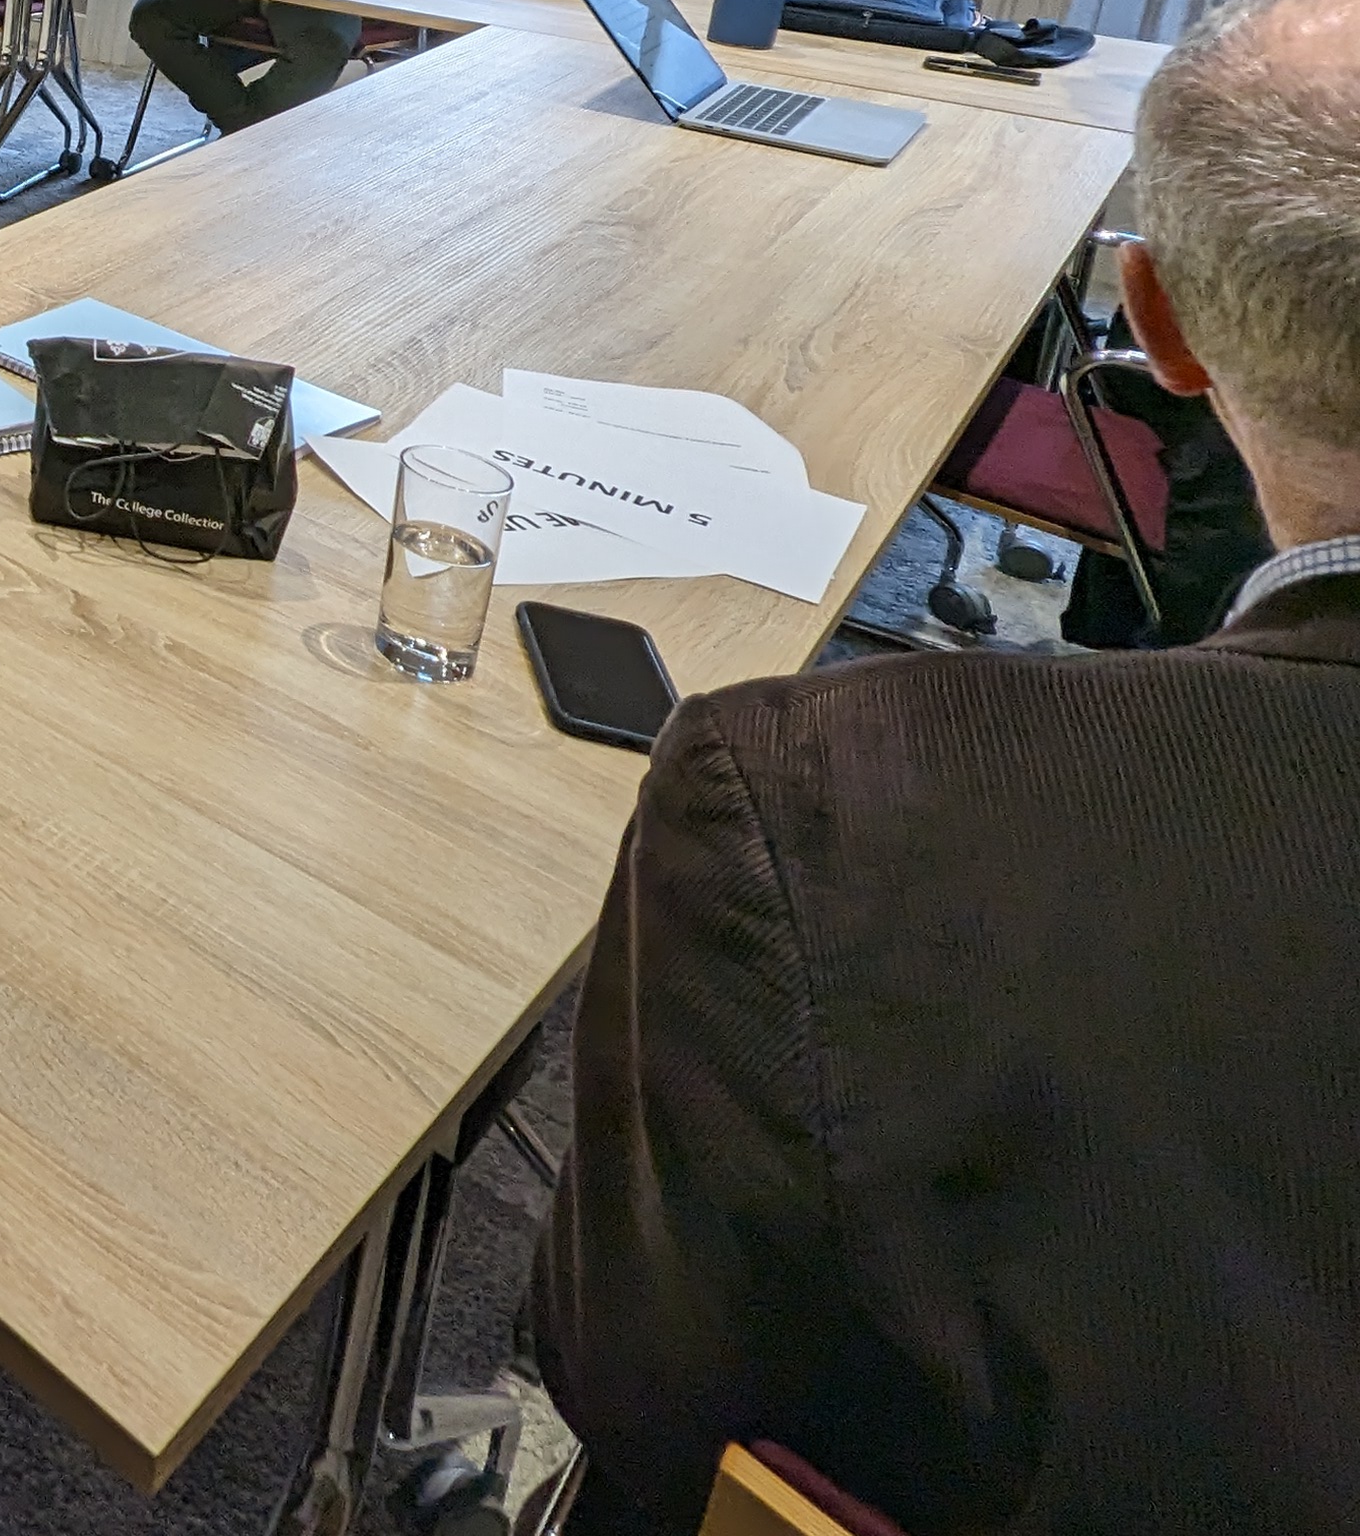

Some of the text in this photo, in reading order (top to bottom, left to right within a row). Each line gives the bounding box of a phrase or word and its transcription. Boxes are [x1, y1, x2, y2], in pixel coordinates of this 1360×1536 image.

[91, 490, 112, 506] The
[492, 449, 713, 527] 5 MINUTES
